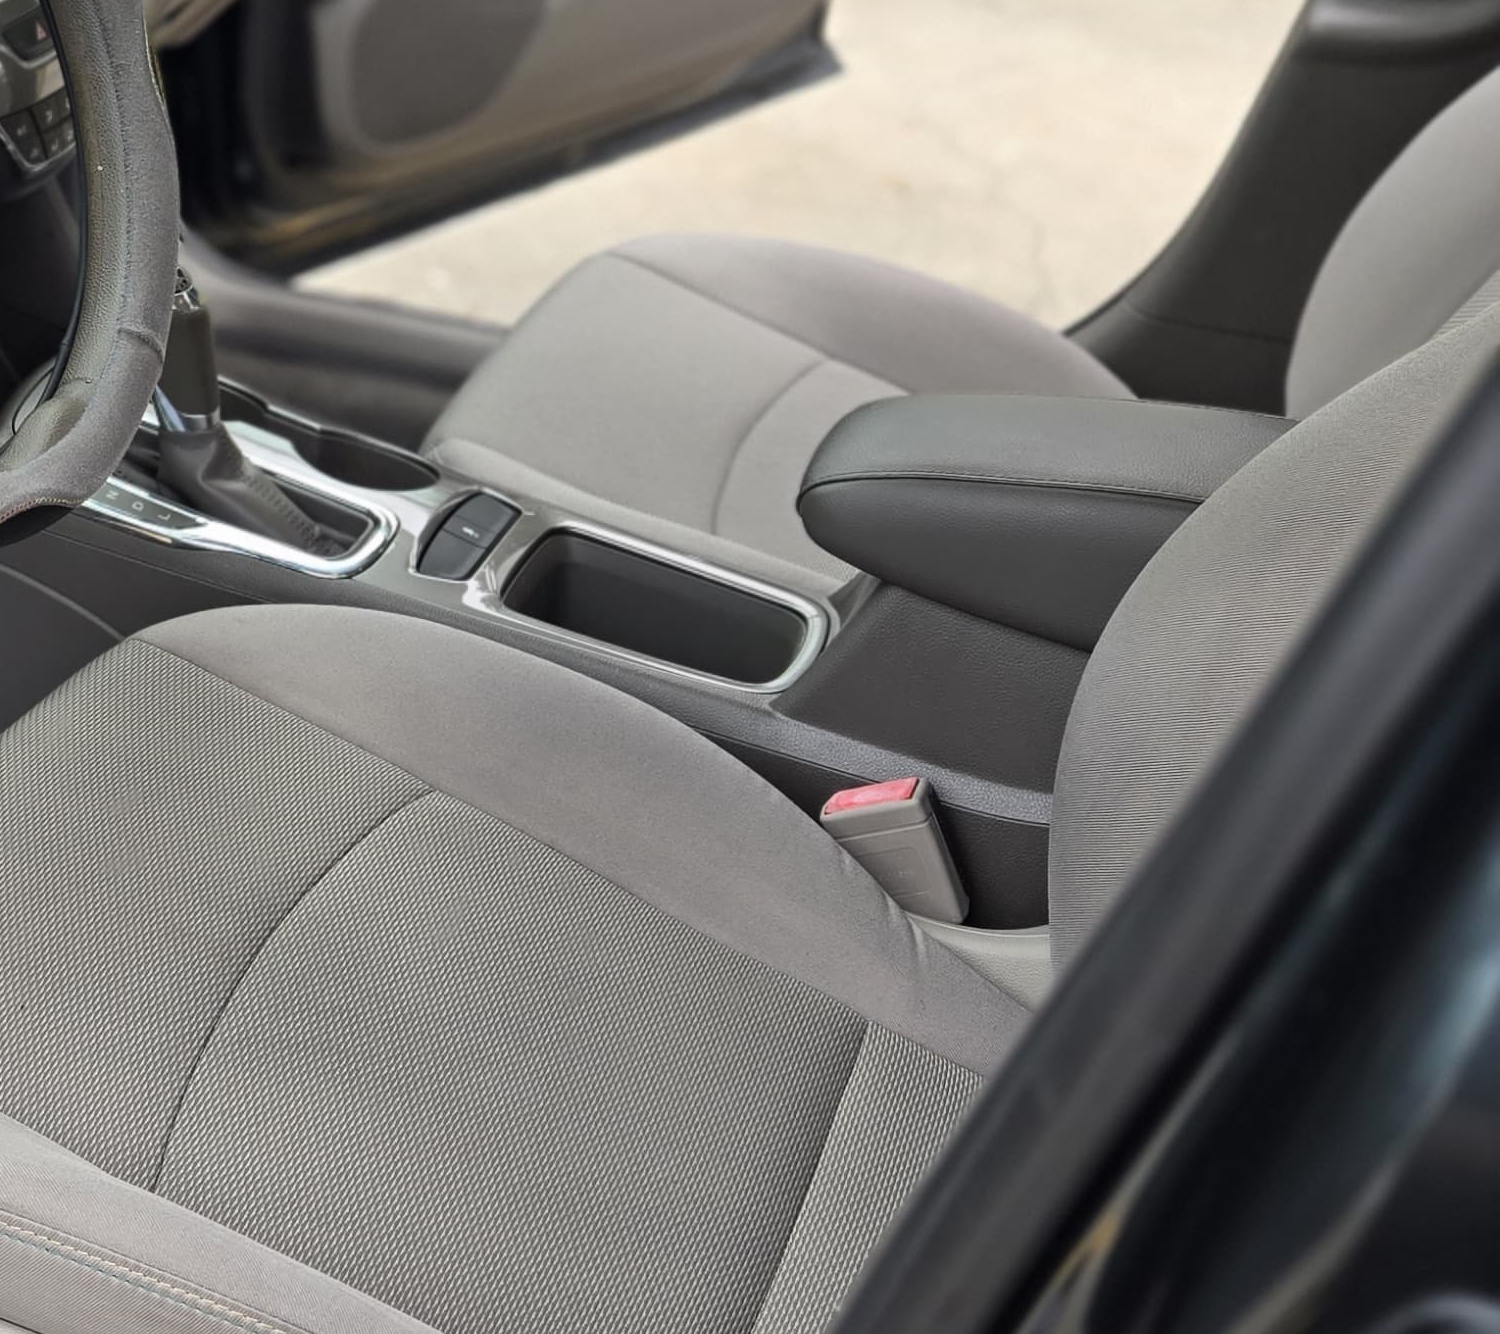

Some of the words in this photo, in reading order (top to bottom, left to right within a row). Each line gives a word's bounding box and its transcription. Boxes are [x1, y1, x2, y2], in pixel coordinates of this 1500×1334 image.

[105, 490, 119, 500] N
[131, 500, 145, 512] D
[156, 513, 172, 522] L
